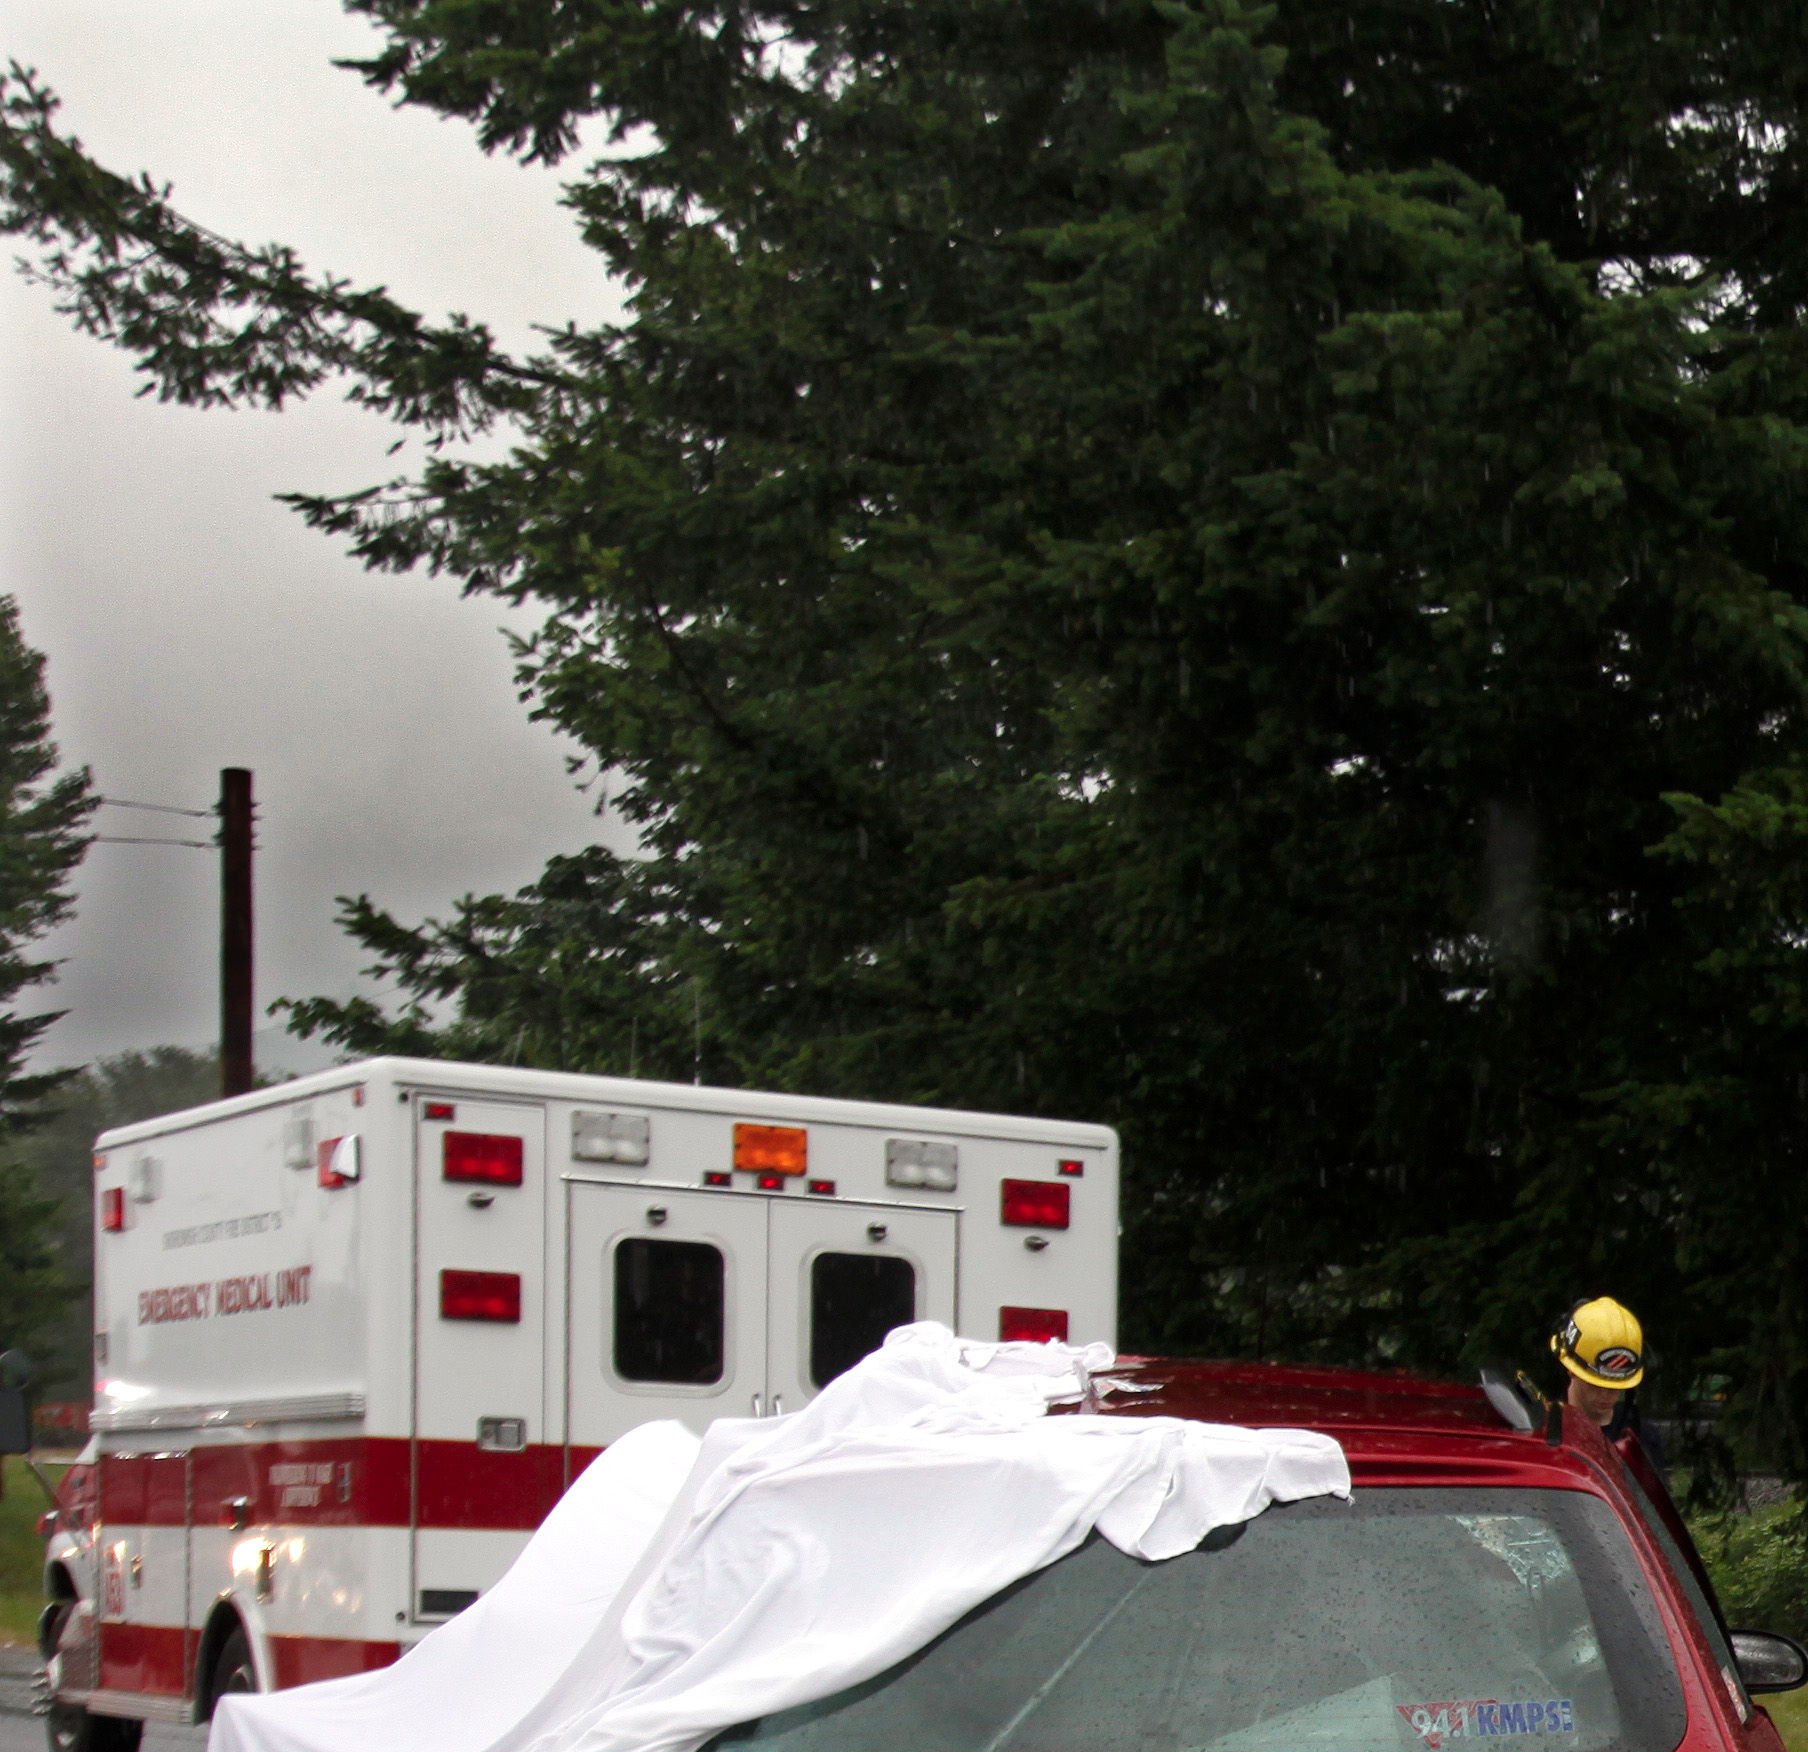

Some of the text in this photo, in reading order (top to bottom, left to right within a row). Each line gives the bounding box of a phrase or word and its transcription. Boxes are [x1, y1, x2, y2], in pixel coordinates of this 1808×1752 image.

[137, 1263, 313, 1326] EMERGENCY MEDICAL UNIT
